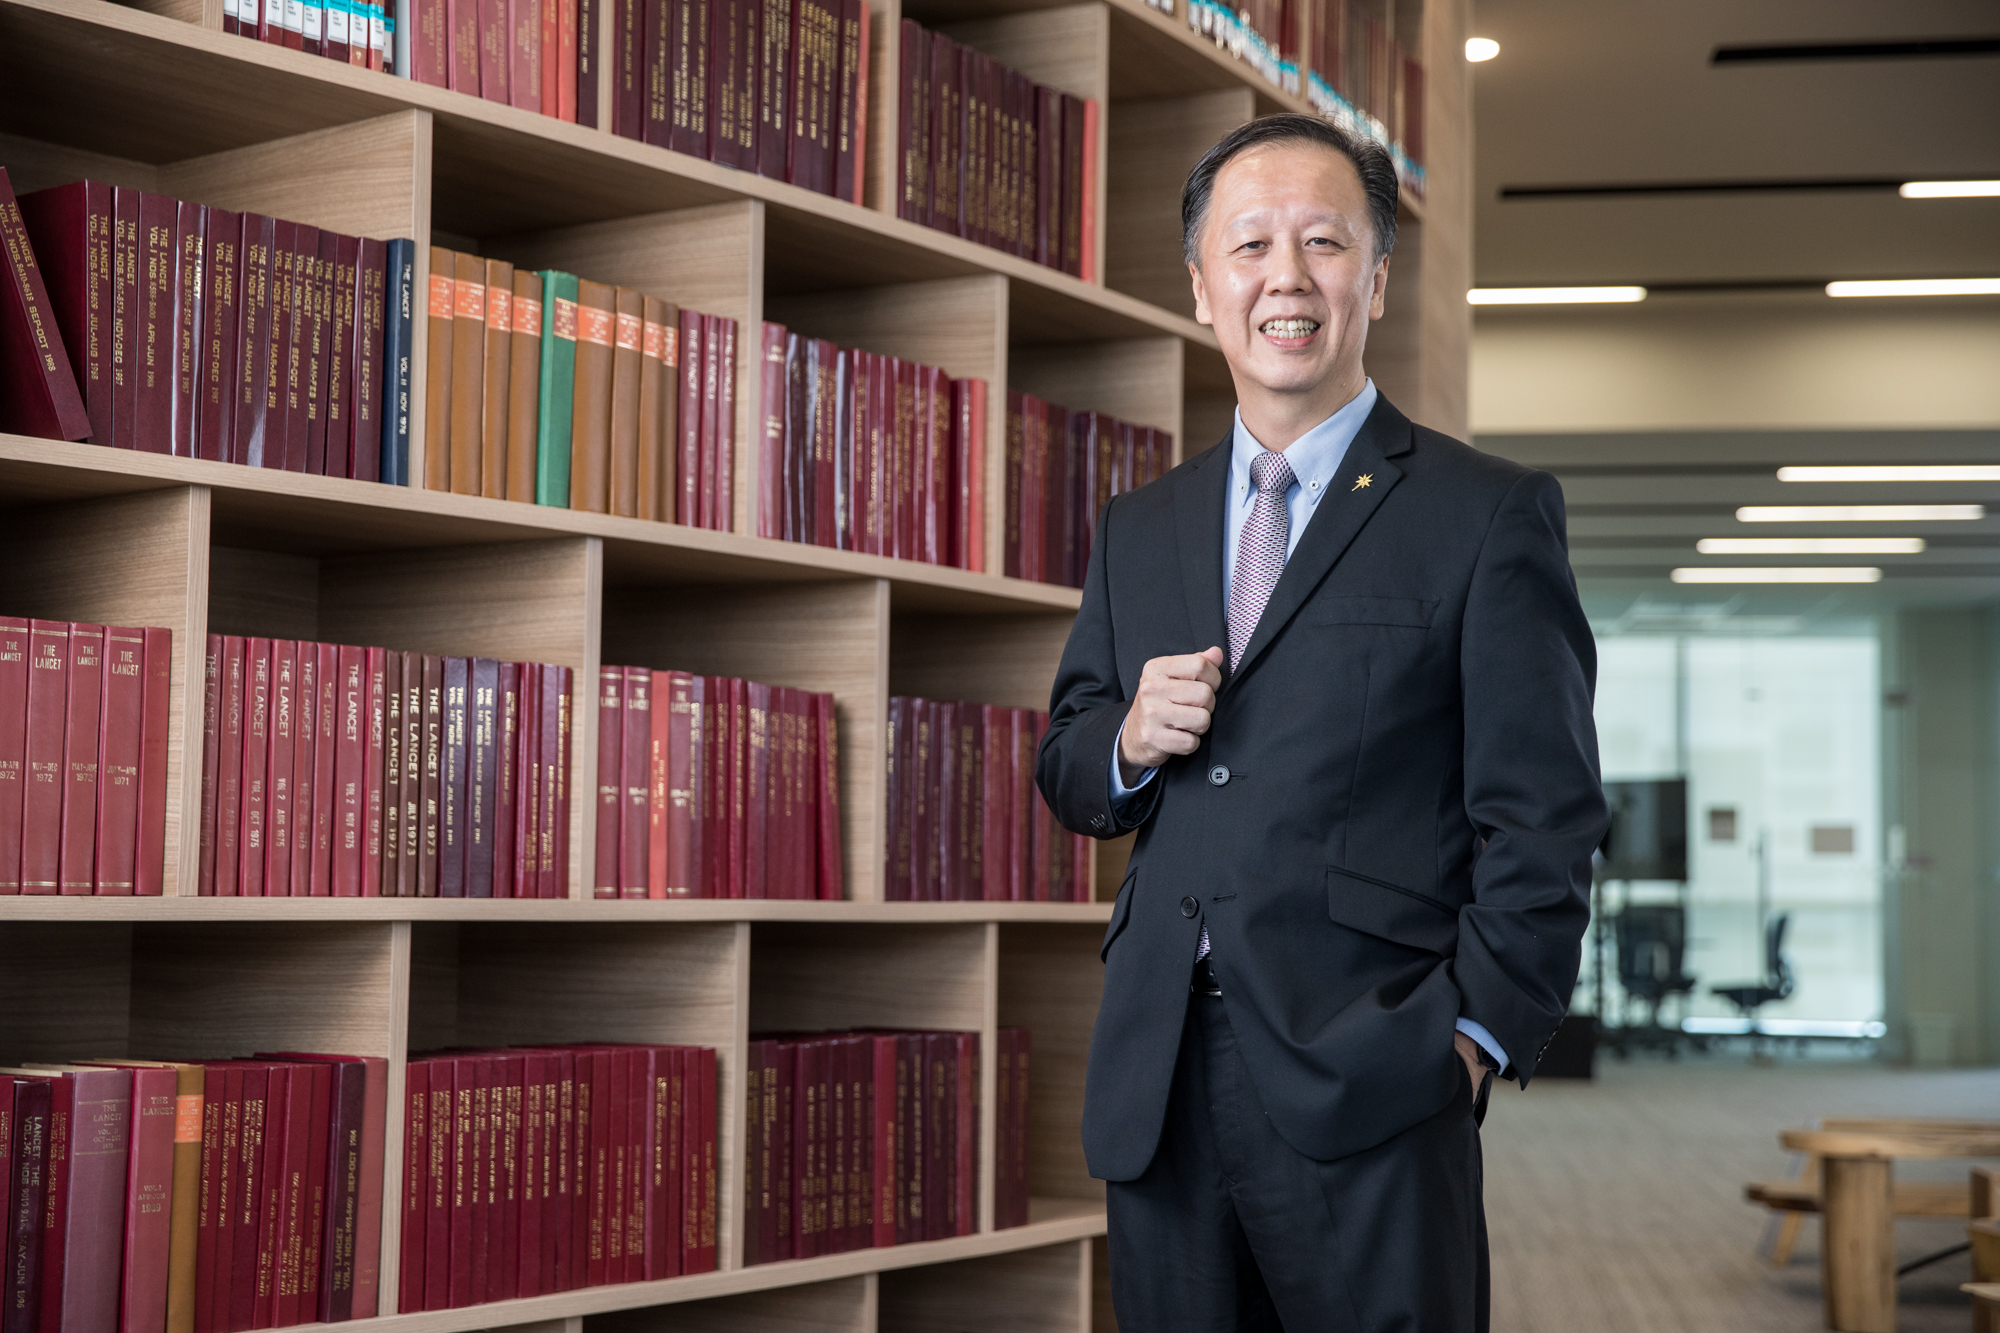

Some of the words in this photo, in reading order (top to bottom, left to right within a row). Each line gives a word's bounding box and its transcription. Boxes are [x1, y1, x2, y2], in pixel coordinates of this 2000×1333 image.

[8, 202, 19, 223] THE
[15, 228, 34, 268] LANCET
[100, 215, 108, 235] THE
[127, 221, 136, 241] THE
[160, 228, 168, 247] THE
[195, 235, 203, 256] THE
[225, 243, 233, 263] THE
[259, 245, 267, 265] THE
[100, 240, 109, 280] LANCET
[127, 245, 135, 286] LANCET
[159, 252, 167, 291] LANCET
[285, 251, 293, 270] THE
[306, 255, 314, 275] THE
[325, 261, 333, 280] THE
[403, 263, 411, 281] THE
[193, 259, 202, 299] LANCET
[224, 267, 233, 307] LANCET
[257, 268, 266, 308] LANCET
[346, 266, 354, 285] THE
[373, 270, 382, 288] THE
[282, 274, 292, 313] LANCET
[303, 279, 312, 318] LANCET
[323, 284, 332, 323] LANCET
[402, 284, 410, 320] LANCET
[344, 288, 353, 326] LANCET
[372, 293, 381, 331] LANCET
[29, 306, 49, 349] SEP-OCT
[90, 313, 98, 357] JUL-AUG
[115, 318, 123, 363] NOV-DEC
[147, 322, 155, 366] APR-JUN
[182, 329, 190, 372] APR-JUN
[211, 339, 220, 382] OCT-DEC
[245, 337, 253, 382] JAN-MAR
[269, 343, 278, 387] MAR-APR
[290, 346, 299, 388] SEP-OCT
[309, 357, 318, 398] JAN-FEB
[331, 355, 341, 399] MAY-JUN
[0, 652, 22, 662] LANCET
[6, 641, 17, 651] THE
[43, 644, 56, 657] THE
[83, 645, 94, 655] THE
[120, 650, 133, 663] THE
[35, 657, 62, 670] LANCET
[77, 656, 98, 666] LANCET
[112, 663, 139, 676] LANCET
[205, 653, 217, 678] THE
[229, 656, 240, 680] THE
[256, 657, 266, 682] THE
[280, 659, 290, 682] THE
[302, 661, 312, 686] THE
[348, 664, 359, 688] THE
[373, 671, 383, 695] THE
[324, 682, 332, 699] THE
[410, 686, 419, 714] THE
[429, 687, 439, 714] THE
[456, 687, 464, 705] THE
[484, 687, 493, 707] THE
[204, 682, 214, 735] LANCET
[228, 684, 238, 735] LANCET
[253, 686, 264, 738] LANCET
[279, 686, 289, 738] LANCET
[301, 689, 311, 741] LANCET
[347, 691, 357, 742] LANCET
[390, 692, 399, 718] THE
[322, 704, 331, 737] LANCET
[372, 699, 382, 750] LANCET
[455, 709, 463, 746] LANCET
[484, 710, 492, 747] LANCET
[389, 728, 399, 786] LANCET
[409, 723, 419, 781] LANCET
[428, 723, 438, 779] LANCET
[36, 773, 53, 782] 1972
[76, 773, 93, 782] 1972
[114, 776, 129, 785] 1971
[251, 780, 261, 794] VOL
[346, 783, 355, 796] VOL
[250, 829, 259, 848] 1975
[103, 1104, 116, 1112] THE
[142, 1107, 174, 1116] LANCET
[151, 1096, 168, 1105] THE
[93, 1113, 122, 1122] LANCET
[30, 1165, 40, 1186] THE
[334, 1227, 343, 1266] LANCET
[333, 1271, 341, 1291] THE
[16, 1290, 26, 1308] 1996
